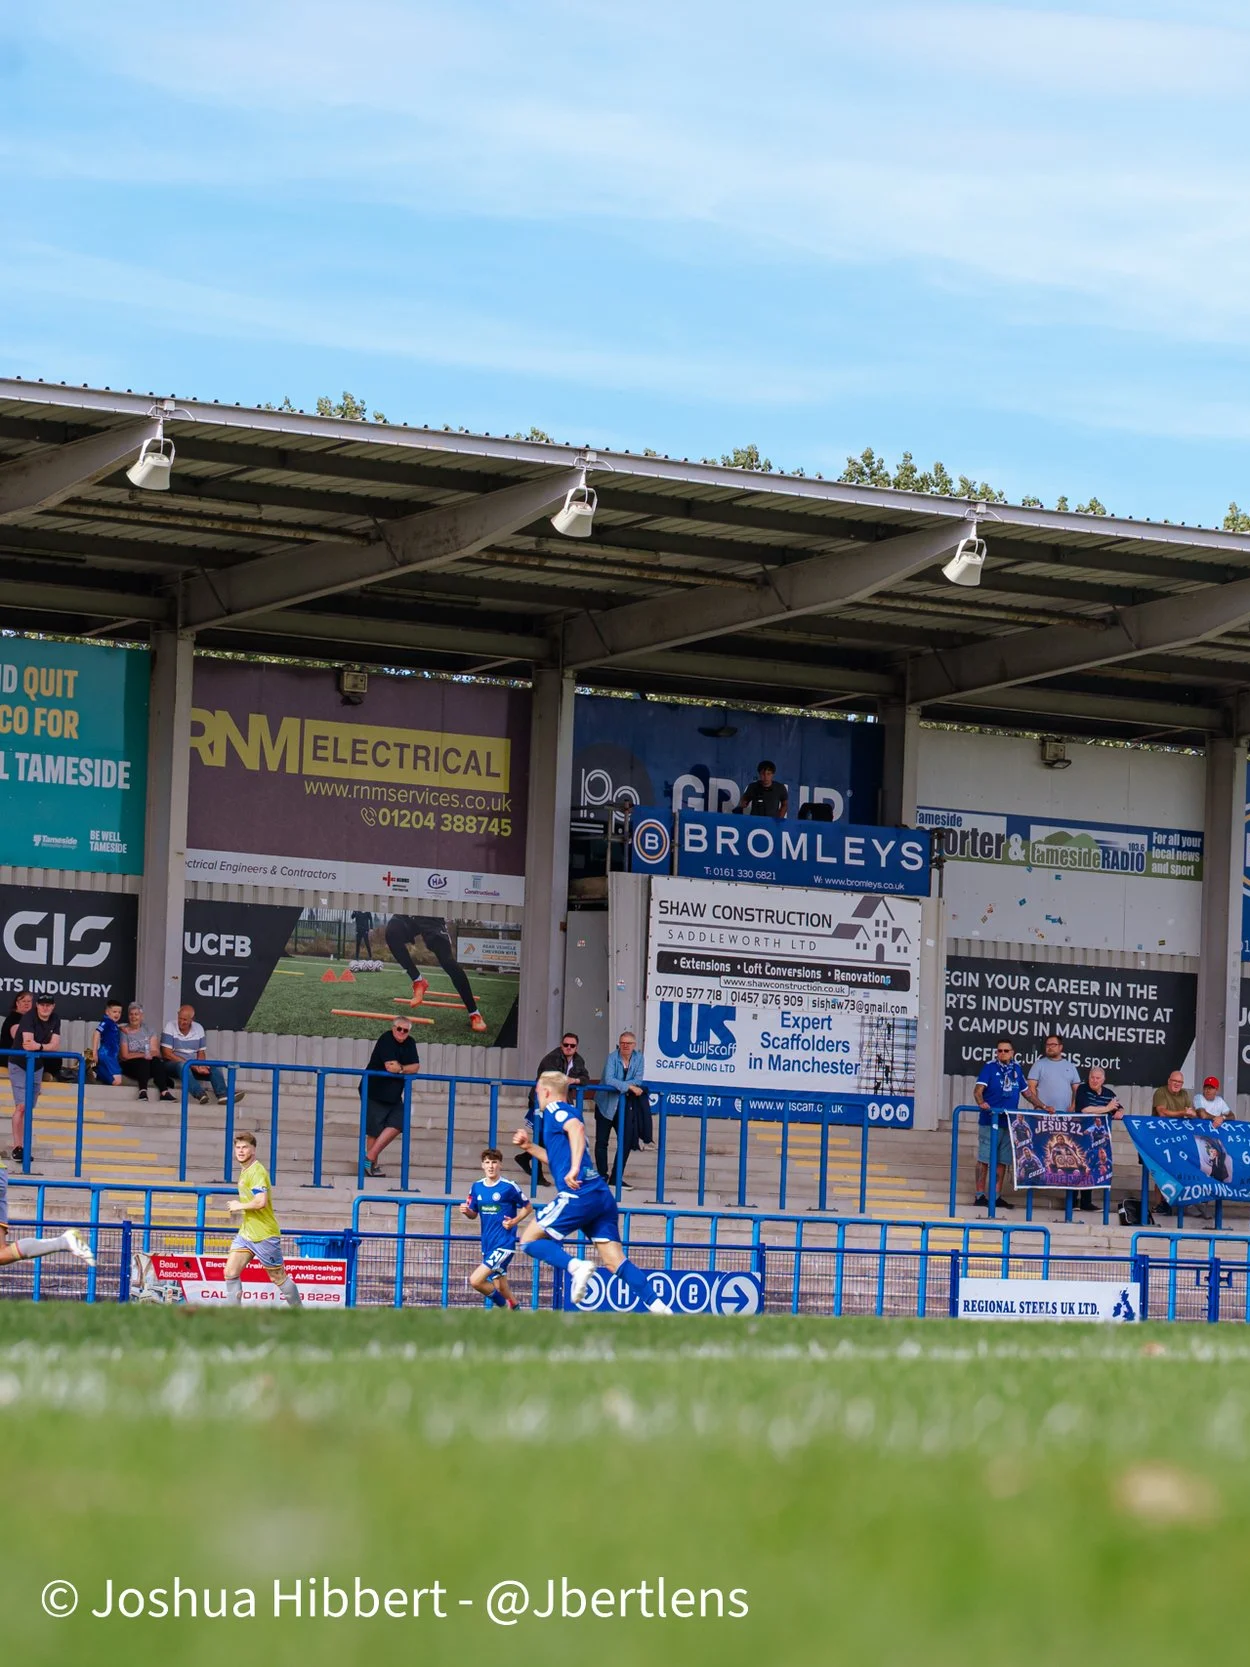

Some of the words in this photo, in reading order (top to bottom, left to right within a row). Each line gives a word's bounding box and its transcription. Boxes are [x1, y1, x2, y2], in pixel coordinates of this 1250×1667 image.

[0, 664, 18, 694] D
[23, 666, 79, 701] QUIT
[0, 704, 29, 735] CO
[33, 707, 80, 740] FOR
[190, 707, 301, 774] RNM
[311, 735, 501, 778] ELECTRICAL
[15, 752, 131, 789] TAMESIDE
[304, 780, 512, 812] www.rnmservices.co.uk
[378, 808, 436, 830] 01204
[440, 813, 512, 837] 388745
[42, 835, 78, 845] Tameside
[90, 830, 101, 841] BE
[102, 831, 121, 842] WELL
[644, 833, 659, 850] B
[684, 823, 924, 871] BROMLEYS
[1009, 834, 1026, 860] &
[1153, 832, 1168, 844] For
[1170, 834, 1180, 846] all
[1181, 836, 1202, 848] your
[90, 841, 128, 854] TAMESIDE
[1153, 848, 1175, 860] local
[1177, 851, 1200, 862] news
[219, 861, 268, 875] Engineers
[270, 865, 277, 875] &
[280, 866, 337, 880] Contractors
[704, 866, 711, 877] T:
[713, 867, 735, 878] 0161
[737, 868, 754, 879] 330
[755, 870, 777, 881] 6821
[813, 874, 823, 885] W:
[824, 877, 905, 891] www.bromleys.co.uk
[1152, 862, 1169, 874] and
[1171, 864, 1195, 877] sport
[659, 900, 707, 918] SHAW
[712, 905, 832, 928] CONSTRUCTION
[3, 911, 114, 968] GIS
[184, 932, 252, 957] UCFB
[668, 929, 781, 949] SADDLEWORTH
[791, 939, 817, 951] LTD
[680, 957, 731, 972] Extensions
[743, 962, 762, 975] Loft
[765, 962, 822, 979] Conversions
[834, 970, 891, 986] Renovations
[28, 979, 112, 998] INDUSTRY
[195, 974, 239, 998] GIS
[723, 977, 846, 995] www.shawconstruction.co.uk
[985, 973, 1030, 991] YOUR
[1035, 976, 1100, 995] CAREER
[1105, 982, 1122, 998] IN
[1127, 984, 1158, 1000] THE
[655, 985, 684, 998] 07710
[686, 987, 705, 1000] 577
[707, 989, 723, 1002] 718
[730, 991, 760, 1006] 01457
[784, 996, 804, 1008] 909
[811, 996, 908, 1015] sishaw73@gmail.com
[982, 996, 1065, 1016] INDUSTRY
[1068, 1001, 1149, 1022] STUDYING
[1153, 1007, 1173, 1023] AT
[781, 1011, 833, 1031] Expert
[959, 1017, 1029, 1036] CAMPUS
[1034, 1022, 1050, 1038] IN
[1056, 1023, 1166, 1046] MANCHESTER
[760, 1031, 850, 1053] Scaffolders
[656, 1059, 717, 1072] SCAFFOLDING
[720, 1064, 735, 1073] LTD
[749, 1053, 762, 1070] in
[768, 1054, 861, 1076] Manchester
[1035, 1121, 1068, 1134] JESUS
[1070, 1123, 1084, 1137] 22
[159, 1260, 179, 1269] Beau
[159, 1270, 198, 1279] Associates
[201, 1290, 227, 1299] CAL
[243, 1291, 275, 1300] 0161
[307, 1293, 341, 1302] 8229
[963, 1300, 1016, 1313] REGIONAL
[1019, 1301, 1057, 1314] STEELS
[1060, 1302, 1075, 1315] UK
[1078, 1303, 1100, 1315] LTD.
